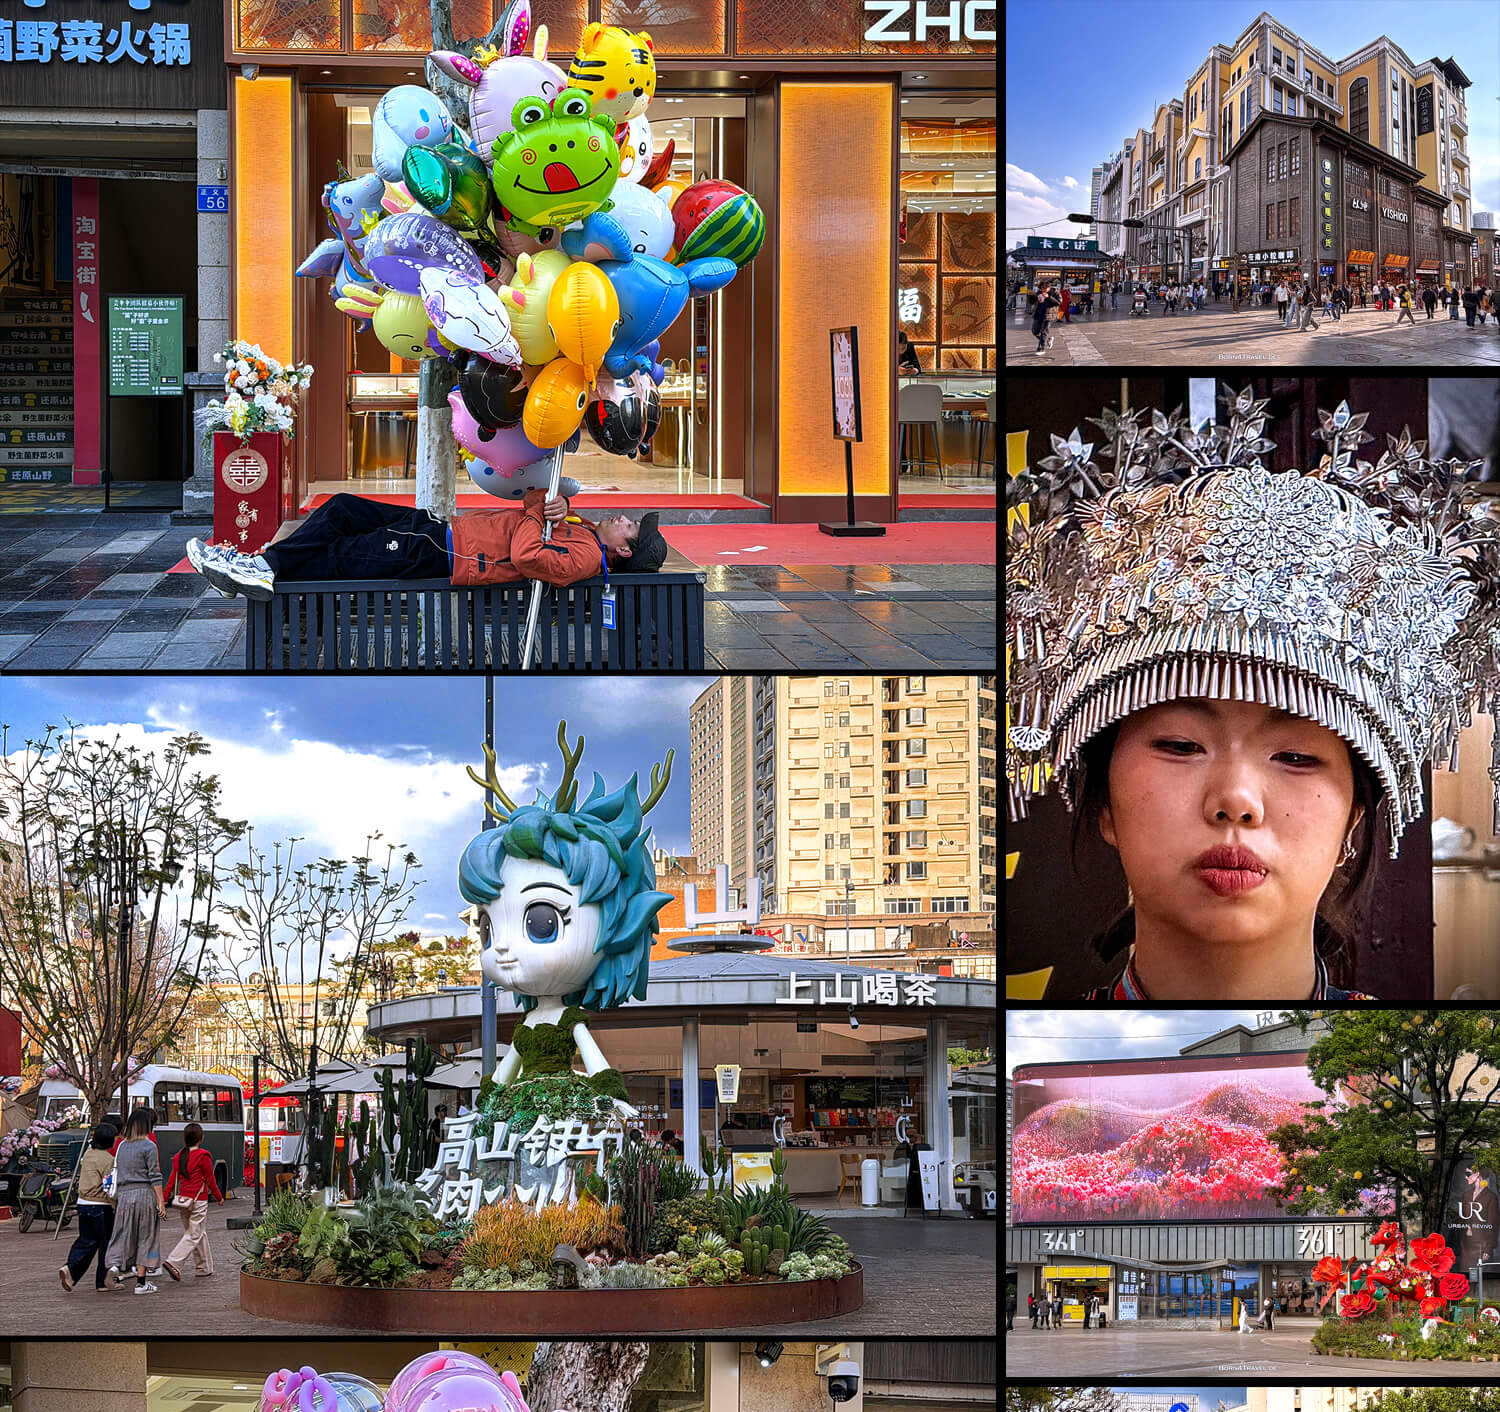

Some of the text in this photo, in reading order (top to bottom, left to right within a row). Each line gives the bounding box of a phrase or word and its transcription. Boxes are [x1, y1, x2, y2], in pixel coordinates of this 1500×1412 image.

[206, 196, 226, 209] 56
[76, 216, 97, 285] 淘宝街
[775, 971, 937, 1006] 上山喝茶
[1458, 1202, 1487, 1222] UR
[1297, 1225, 1344, 1254] 361°
